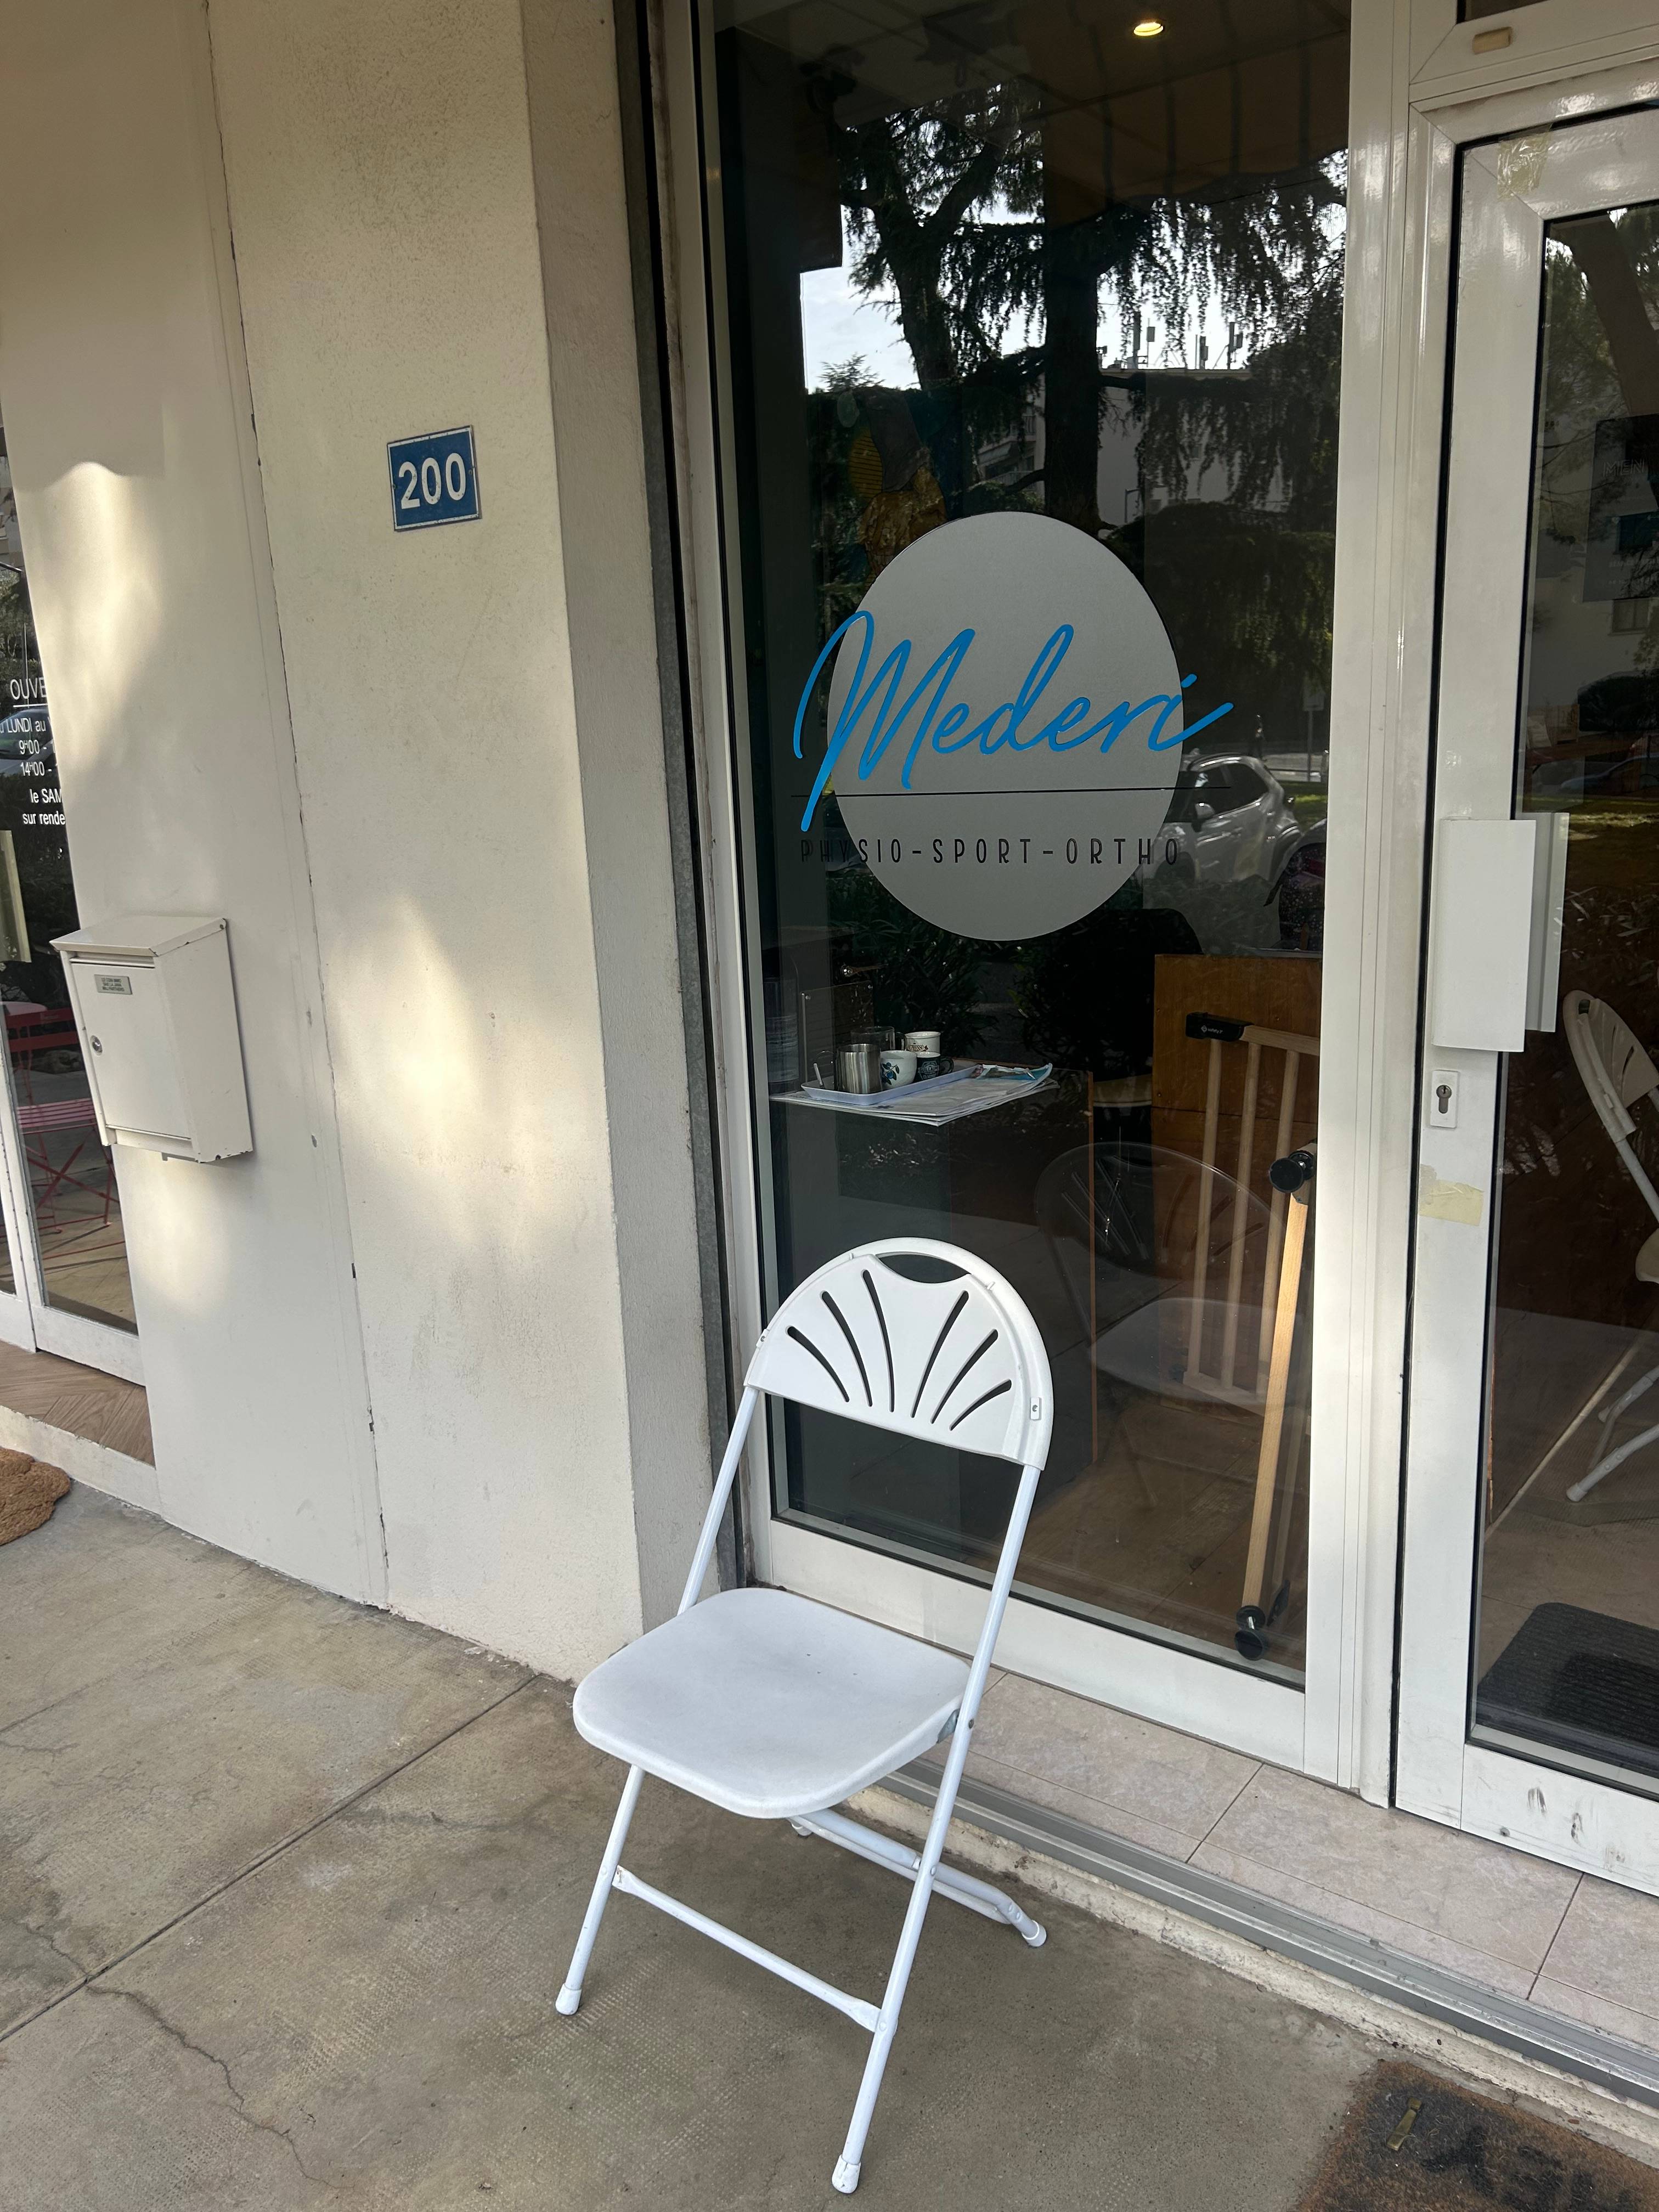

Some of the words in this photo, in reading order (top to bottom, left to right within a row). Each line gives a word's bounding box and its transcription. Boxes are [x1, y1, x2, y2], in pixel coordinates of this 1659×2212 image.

[398, 453, 466, 510] 200
[6, 718, 33, 733] LUNDI
[35, 720, 46, 732] au
[793, 610, 1234, 832] Mederi
[20, 761, 45, 776] 14H00
[30, 788, 39, 803] le
[22, 813, 36, 825] sur
[39, 810, 65, 825] rende
[800, 838, 1178, 865] PHYSIO-SPORT-ORTHO
